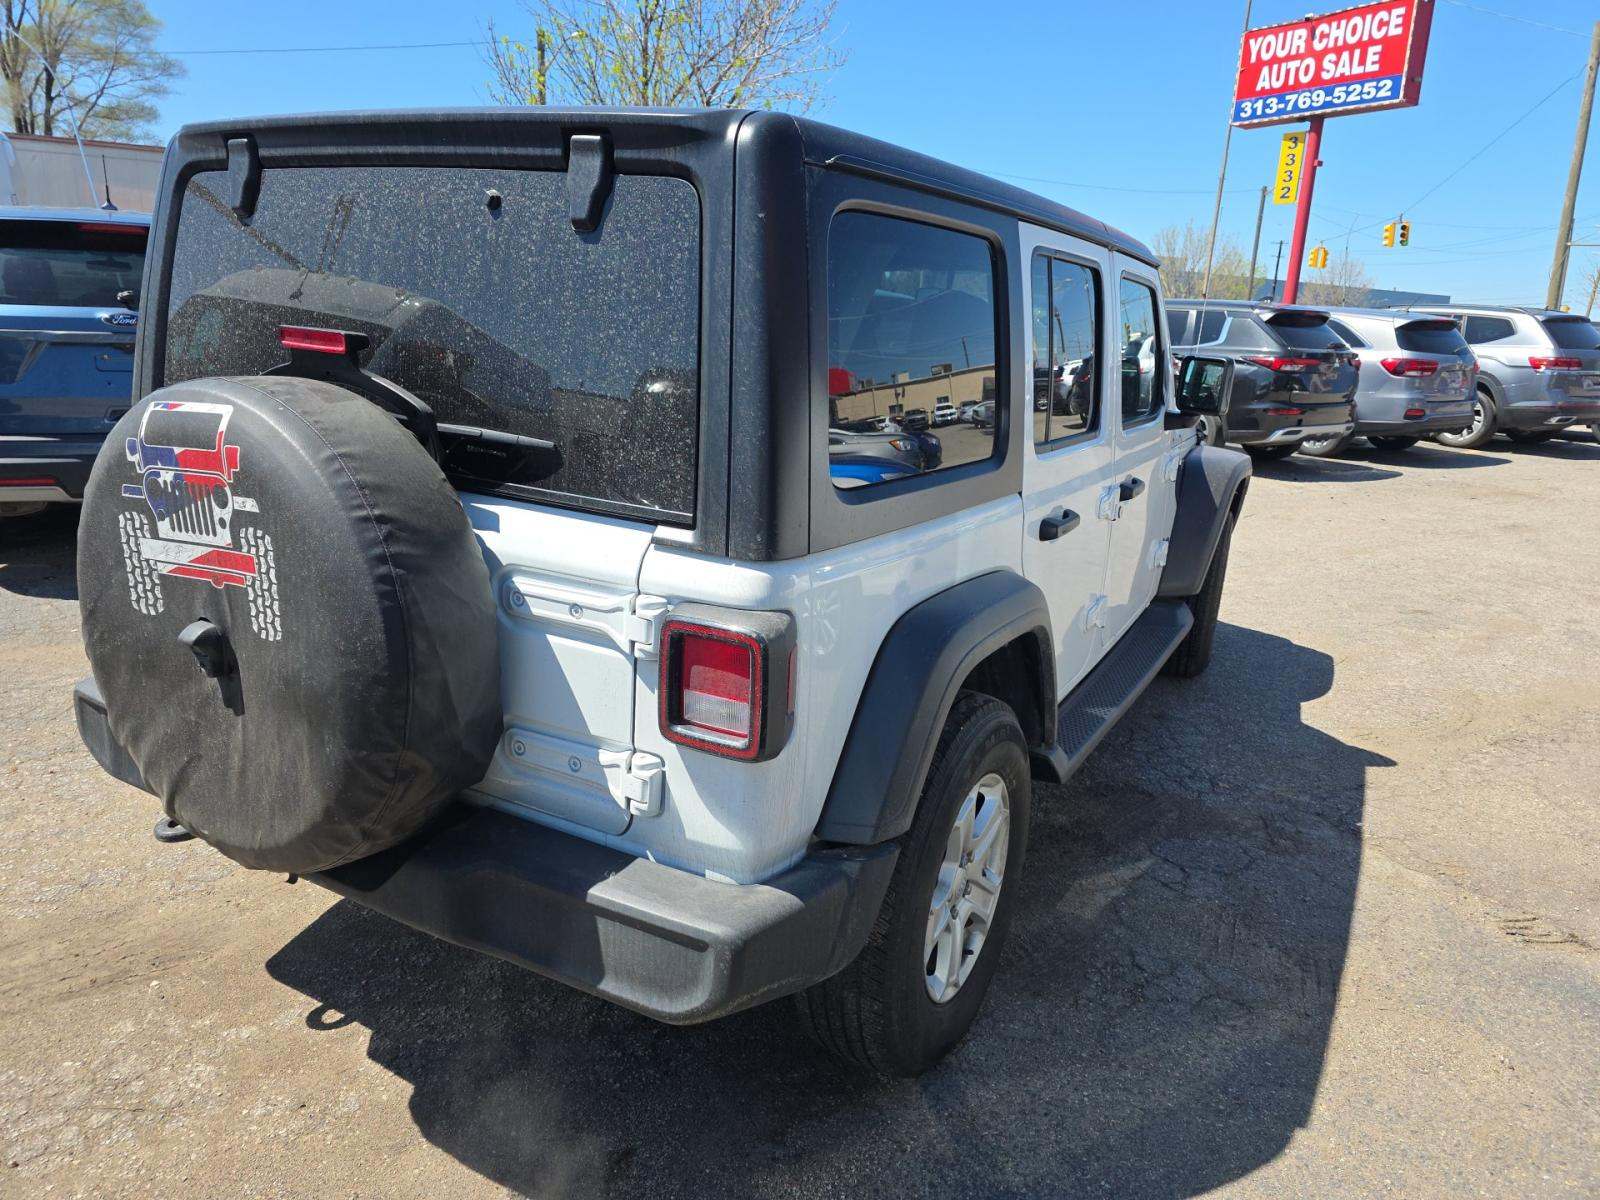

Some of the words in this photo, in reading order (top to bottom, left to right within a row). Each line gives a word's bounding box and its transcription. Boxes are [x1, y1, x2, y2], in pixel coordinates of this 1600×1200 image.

[1249, 28, 1308, 63] YOUR
[1313, 7, 1406, 51] CHOICE
[1256, 57, 1315, 91] AUTO
[1321, 45, 1382, 80] SALE
[1240, 79, 1393, 117] 313-769-5252
[1280, 136, 1298, 199] 3332
[112, 313, 138, 325] Ford
